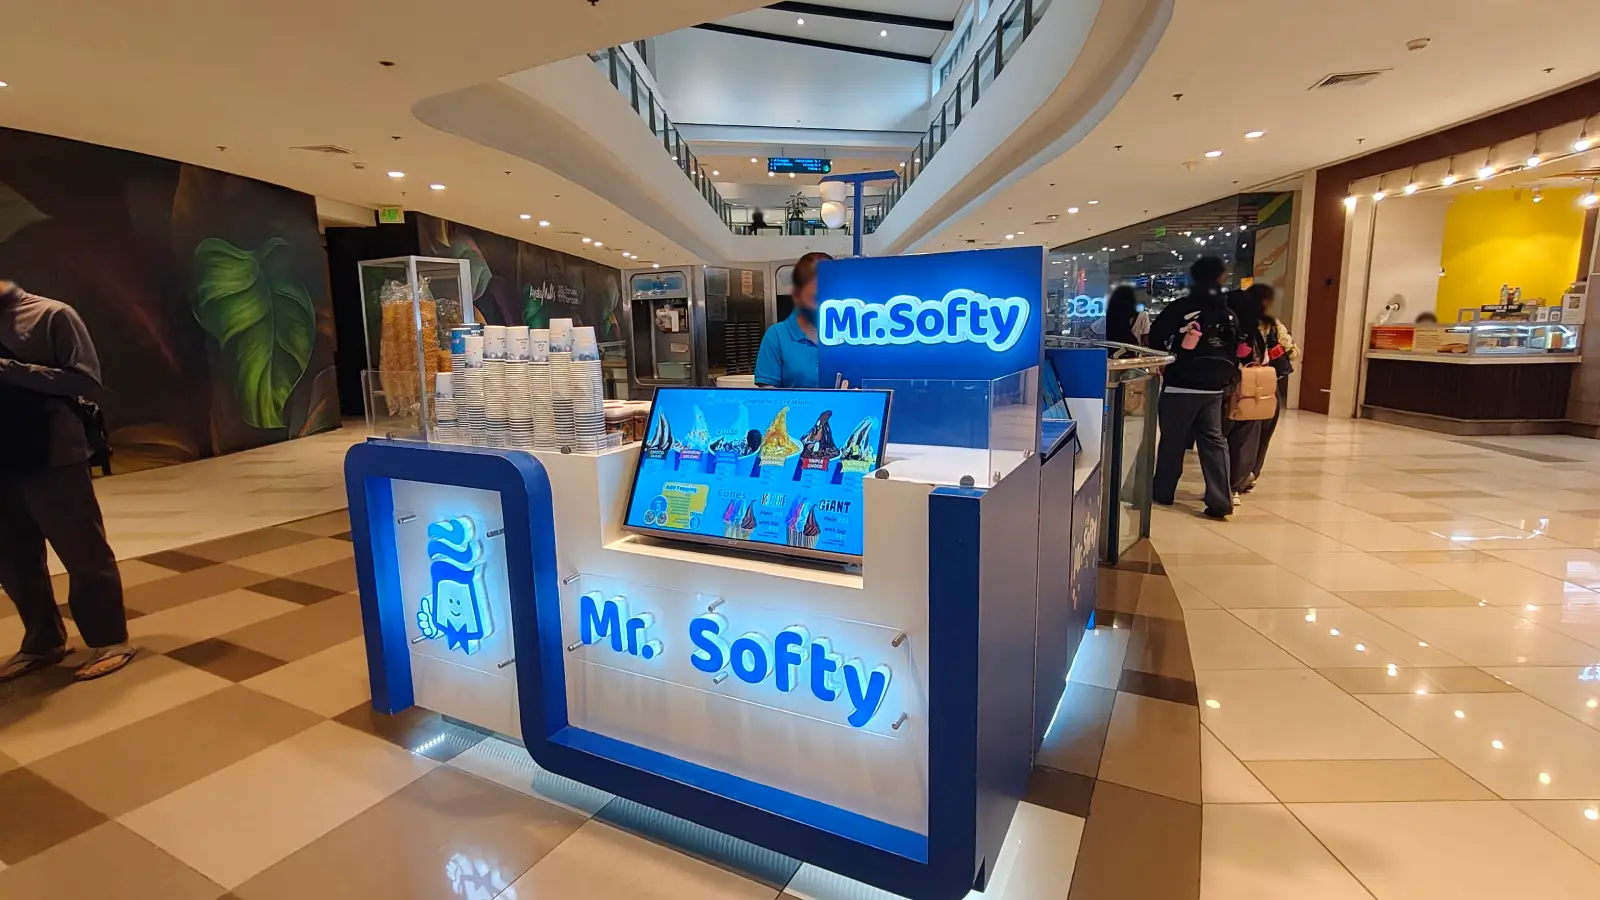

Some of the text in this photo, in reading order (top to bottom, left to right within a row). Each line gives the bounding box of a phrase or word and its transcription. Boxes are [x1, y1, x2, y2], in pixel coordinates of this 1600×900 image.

[824, 296, 1020, 346] Mr.Softy
[580, 592, 889, 728] Mr. Softy
